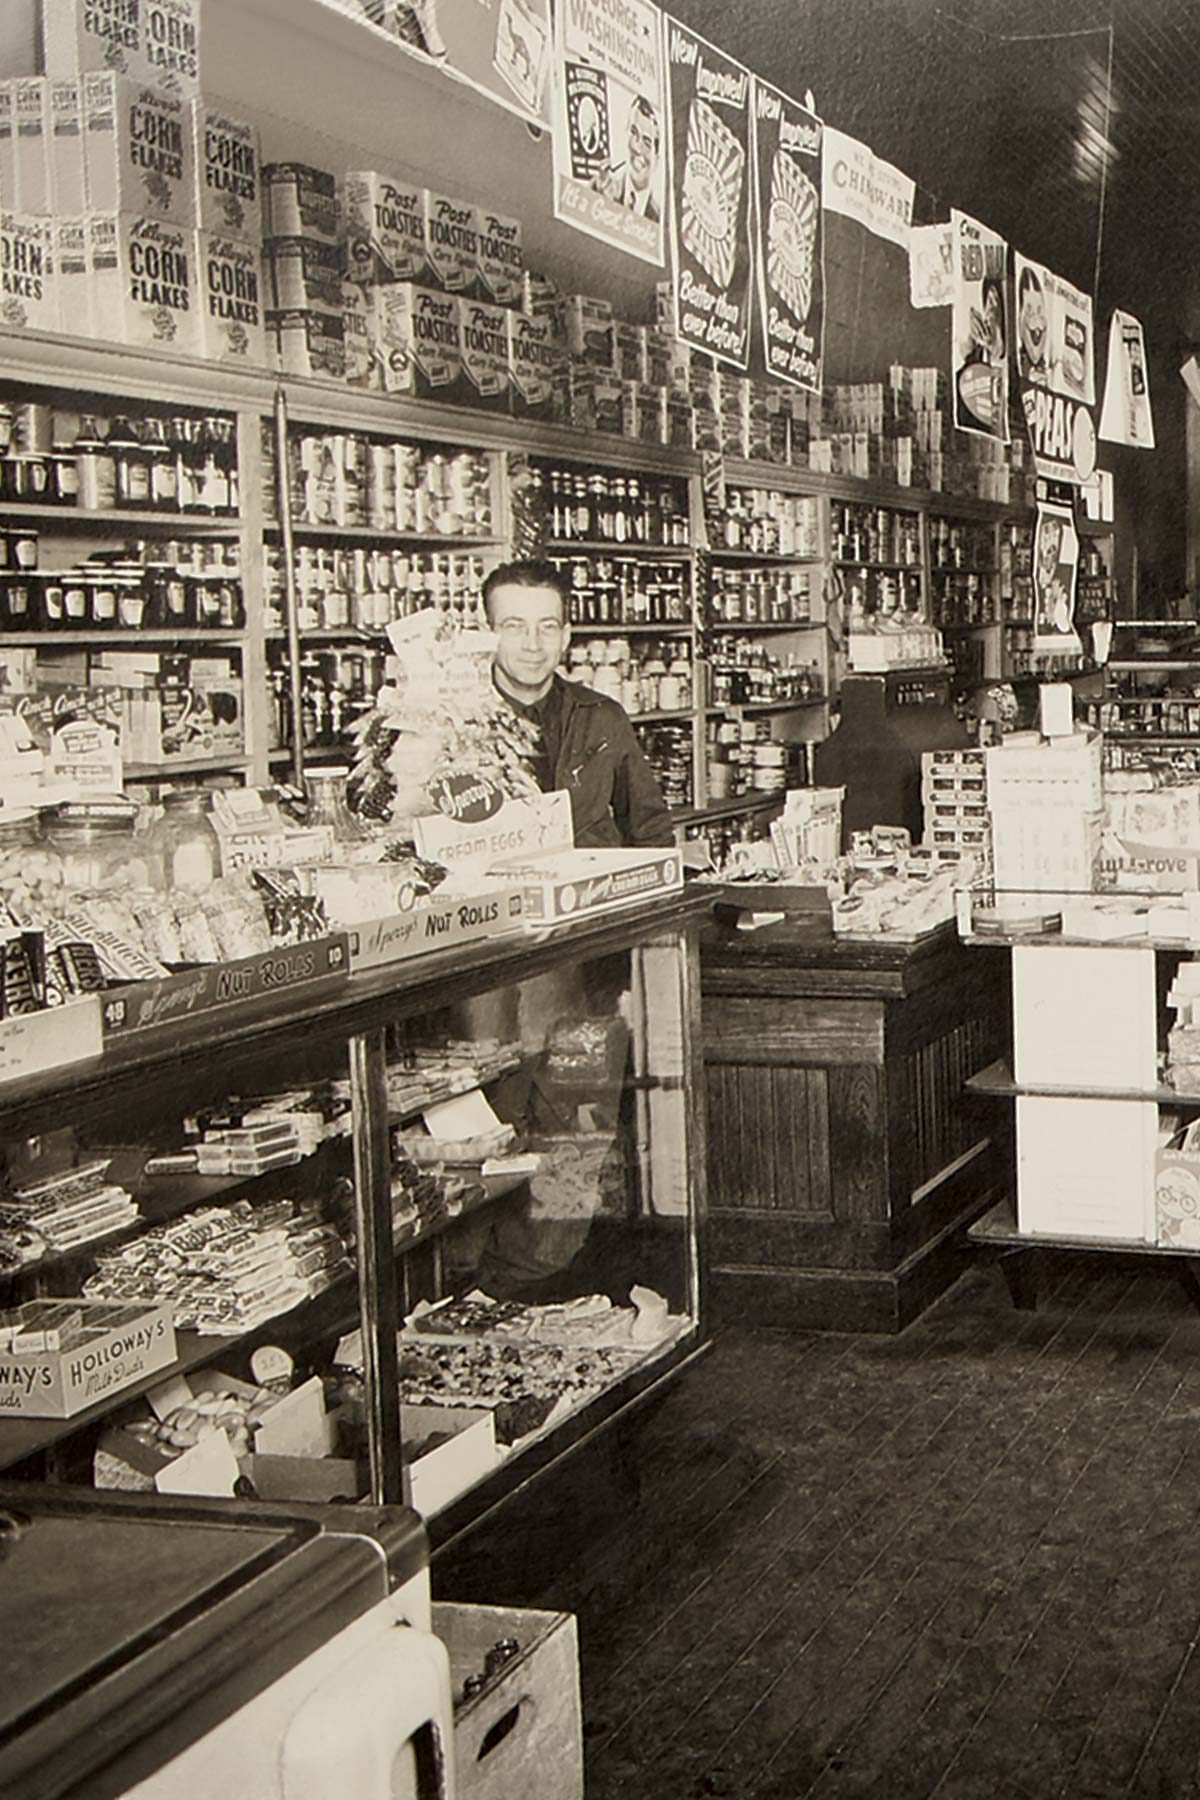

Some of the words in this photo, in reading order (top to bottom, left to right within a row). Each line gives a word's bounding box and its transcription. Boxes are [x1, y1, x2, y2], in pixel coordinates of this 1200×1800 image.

[84, 11, 140, 50] FLAKES
[147, 9, 196, 55] ORN
[147, 43, 196, 77] LAKES
[130, 105, 183, 157] CORN
[130, 141, 183, 180] FLAKES
[205, 130, 255, 181] CORN
[206, 164, 256, 201] FLAKES
[380, 185, 418, 210] Post
[374, 204, 425, 241] TOASTIES
[435, 200, 473, 226] Post
[485, 216, 519, 241] Post
[429, 219, 478, 256] TOASTIES
[479, 235, 524, 268] TOASTIES
[129, 242, 189, 288] CORN
[207, 259, 259, 302] CORN
[130, 278, 190, 312] FLAKES
[208, 294, 260, 327] FLAKES
[417, 294, 453, 318] Post
[412, 313, 460, 347] TOASTIES
[468, 307, 503, 331] Post
[517, 319, 549, 341] Post
[464, 325, 509, 361] TOASTIES
[490, 829, 525, 851] EGGS
[425, 913, 453, 937] NUT
[459, 902, 499, 928] ROLLS
[105, 1000, 125, 1022] 48
[216, 968, 253, 1000] NUT
[261, 952, 315, 987] ROLLS
[70, 1319, 165, 1387] HOLLOWAY'S
[84, 1372, 113, 1398] Milk
[113, 1356, 144, 1385] Duds
